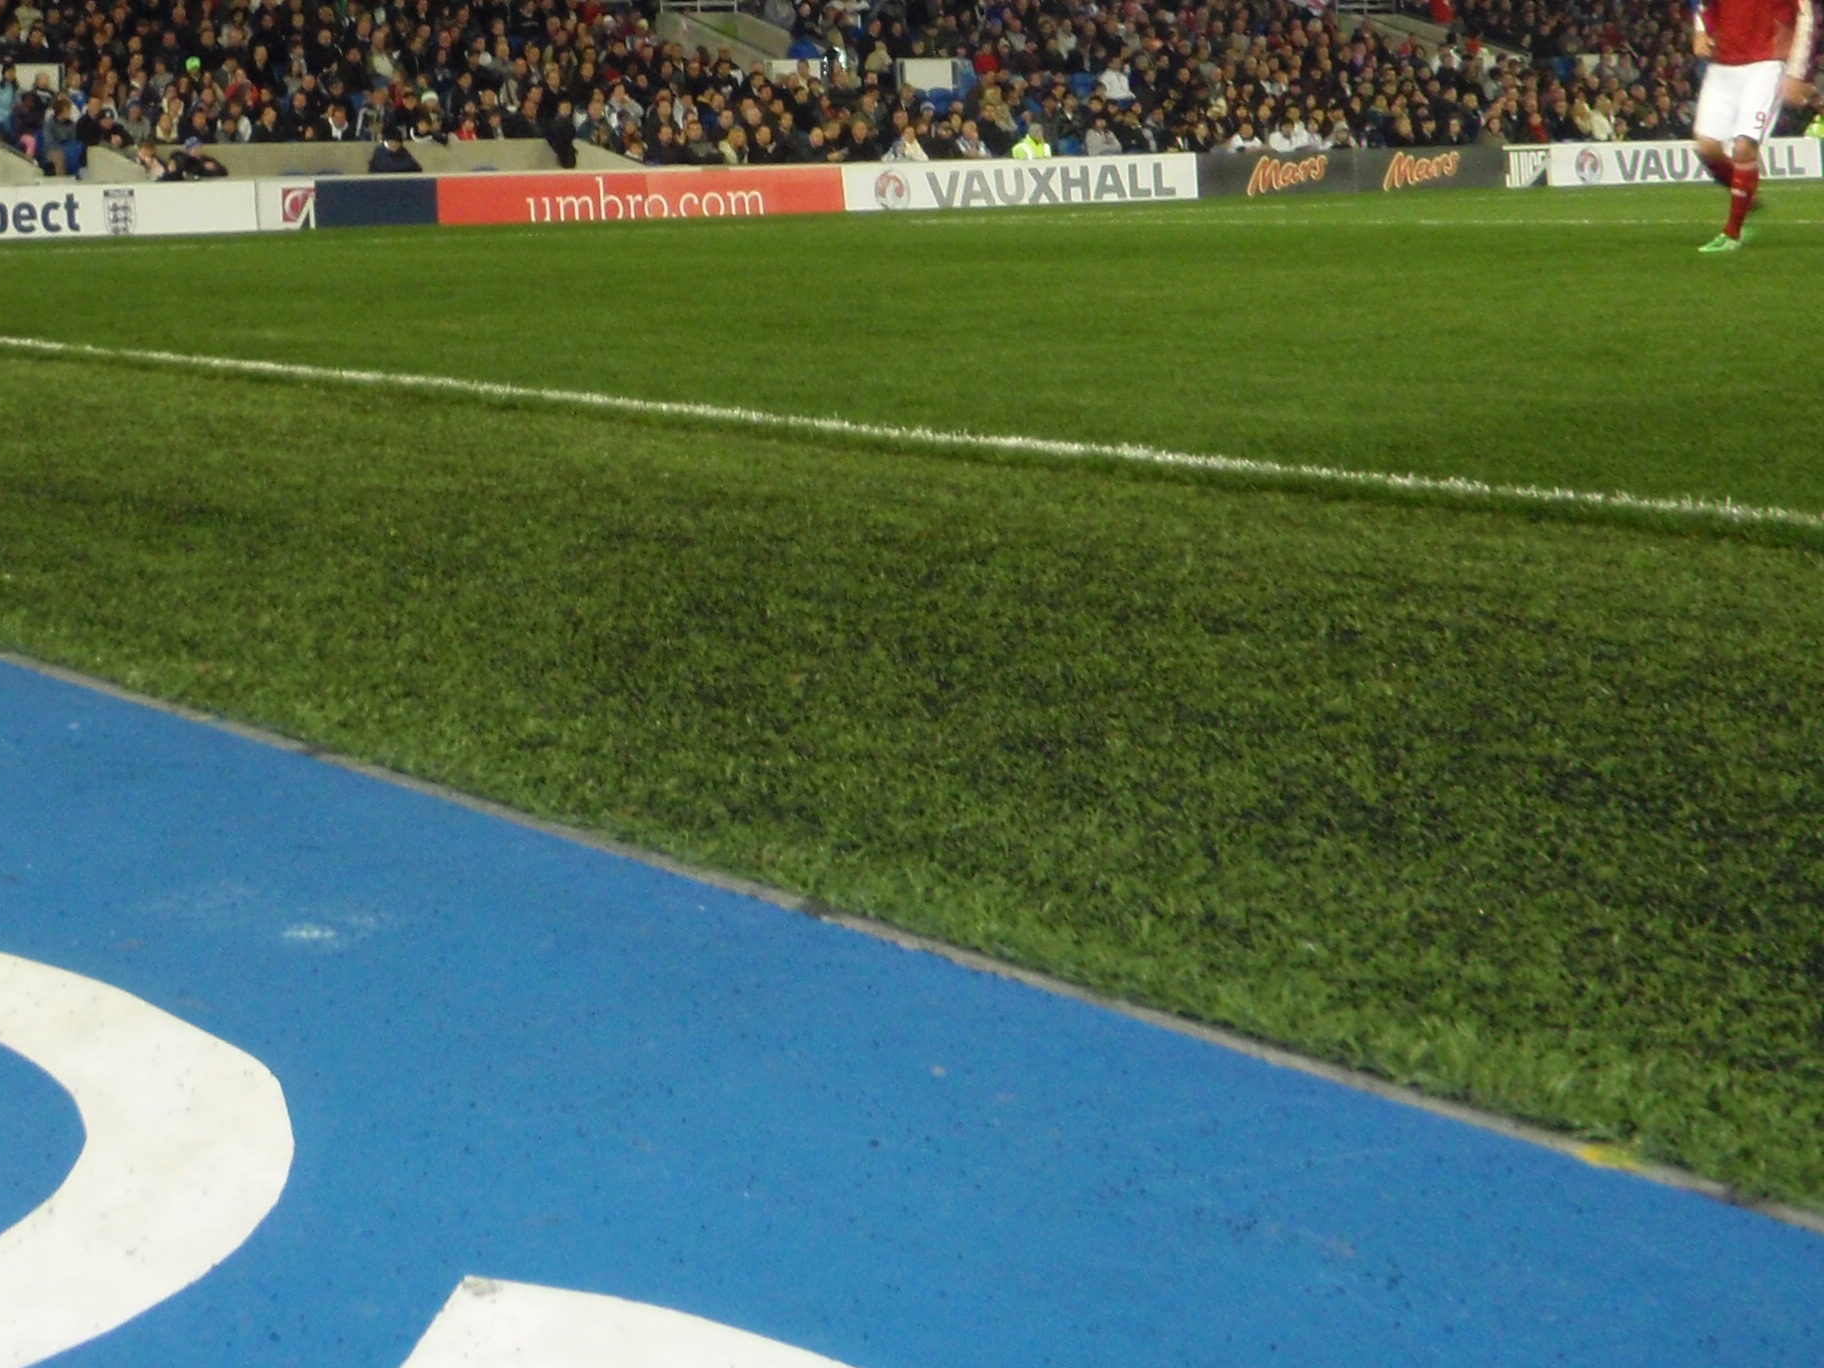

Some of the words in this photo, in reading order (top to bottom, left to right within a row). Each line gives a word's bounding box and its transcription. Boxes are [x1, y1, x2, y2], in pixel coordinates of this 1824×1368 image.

[1753, 111, 1767, 129] 9
[925, 158, 1177, 209] VAUXHALL
[1246, 154, 1327, 196] Mars
[1382, 150, 1461, 191] Mars
[526, 176, 766, 223] umbro.com
